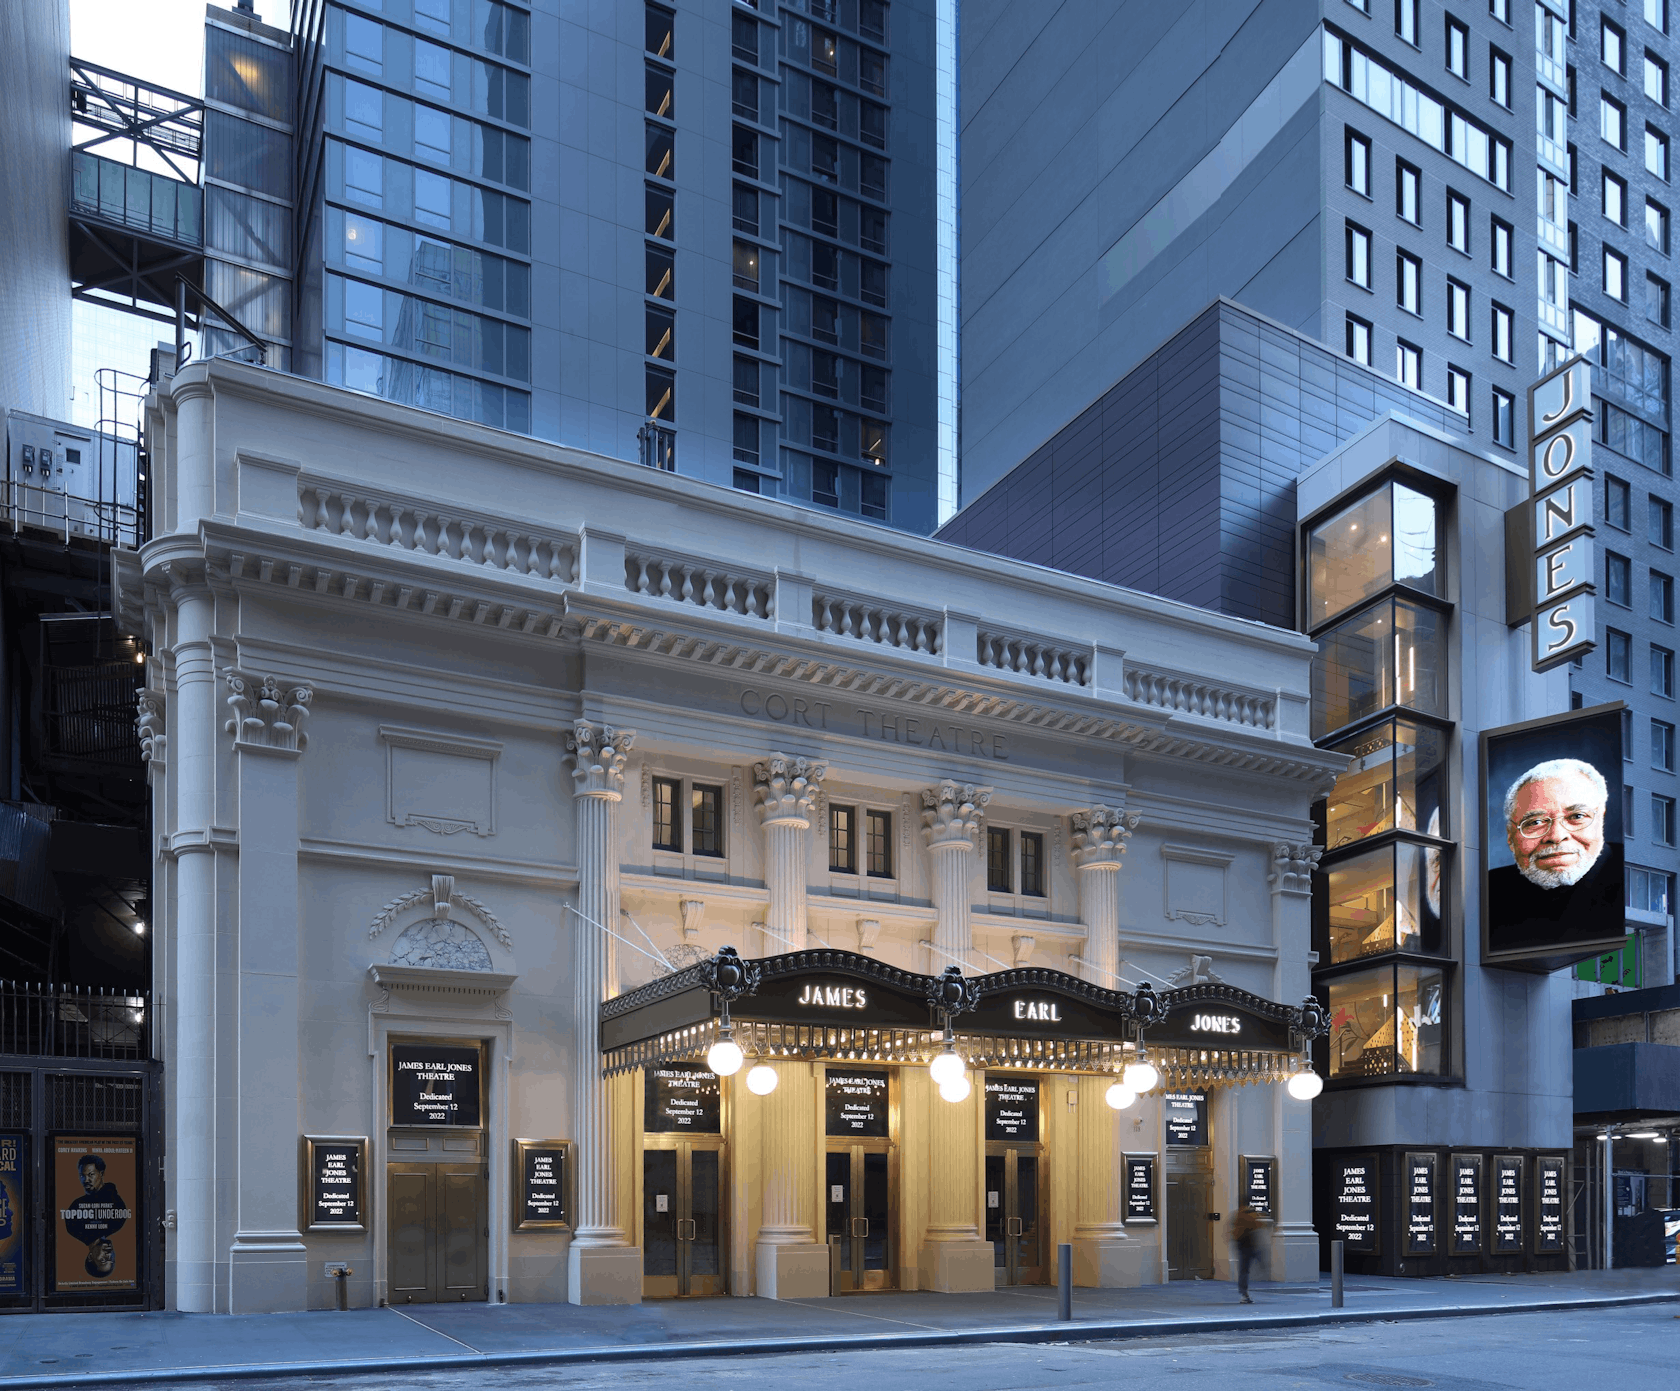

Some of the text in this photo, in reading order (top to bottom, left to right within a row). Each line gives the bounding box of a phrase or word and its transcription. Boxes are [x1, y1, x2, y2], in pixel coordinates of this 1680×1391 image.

[1543, 370, 1575, 652] JONES
[740, 689, 1009, 760] CORT THEATRE
[798, 985, 868, 1008] JAMES
[1014, 1000, 1062, 1022] EARL
[1190, 1014, 1241, 1033] JONES
[398, 1062, 423, 1070] JAMES
[447, 1064, 472, 1072] JONES
[414, 1103, 448, 1111] September
[666, 1108, 695, 1116] September
[996, 1118, 1020, 1126] September
[1343, 1168, 1365, 1176] JAMES
[1413, 1167, 1428, 1176] JAMES
[1343, 1187, 1366, 1195] JONES
[1414, 1187, 1428, 1195] JONES
[1336, 1224, 1366, 1232] September
[1409, 1225, 1428, 1233] September
[1455, 1225, 1474, 1233] September
